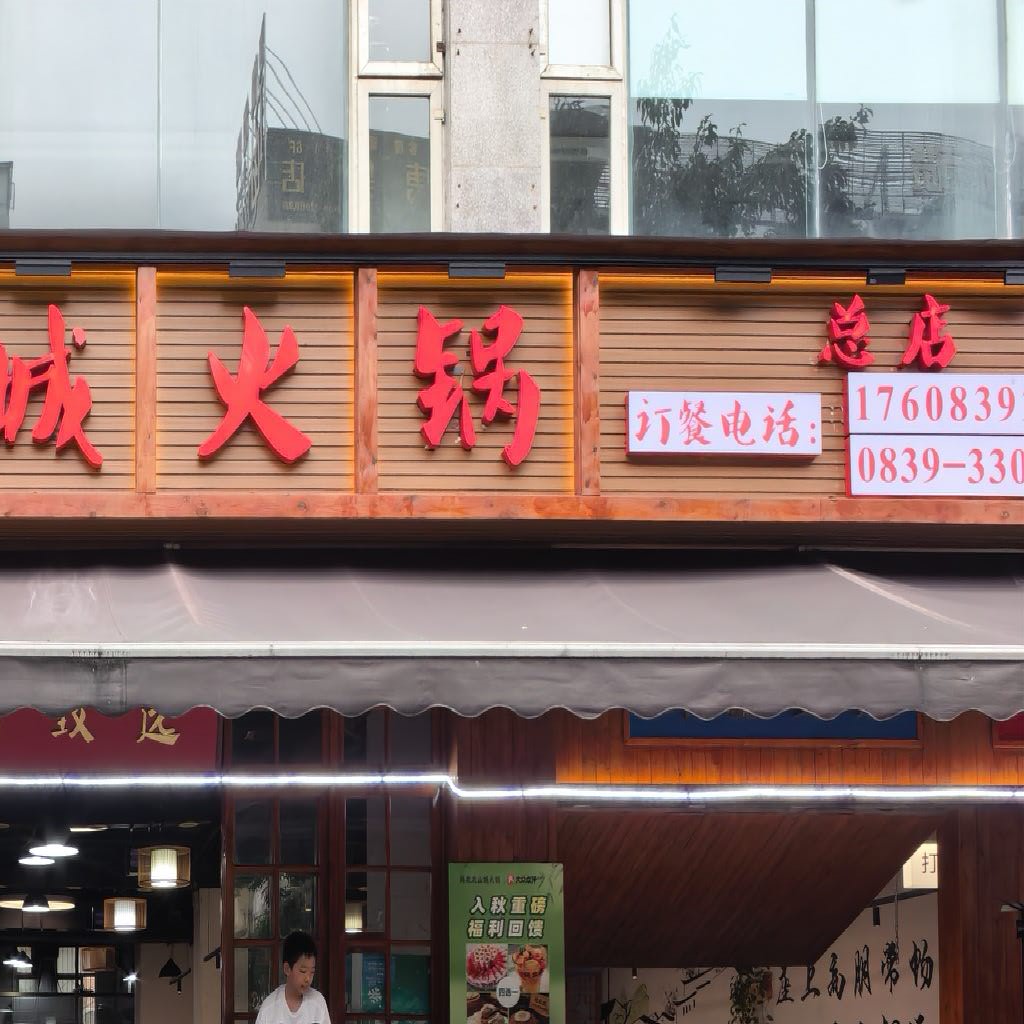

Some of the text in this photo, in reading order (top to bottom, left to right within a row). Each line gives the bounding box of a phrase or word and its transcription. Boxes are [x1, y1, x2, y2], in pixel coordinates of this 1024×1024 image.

[818, 293, 957, 369] 总店
[857, 384, 1024, 422] 1760839
[470, 896, 547, 915] 入秋重磅
[467, 919, 545, 939] 福利回馈
